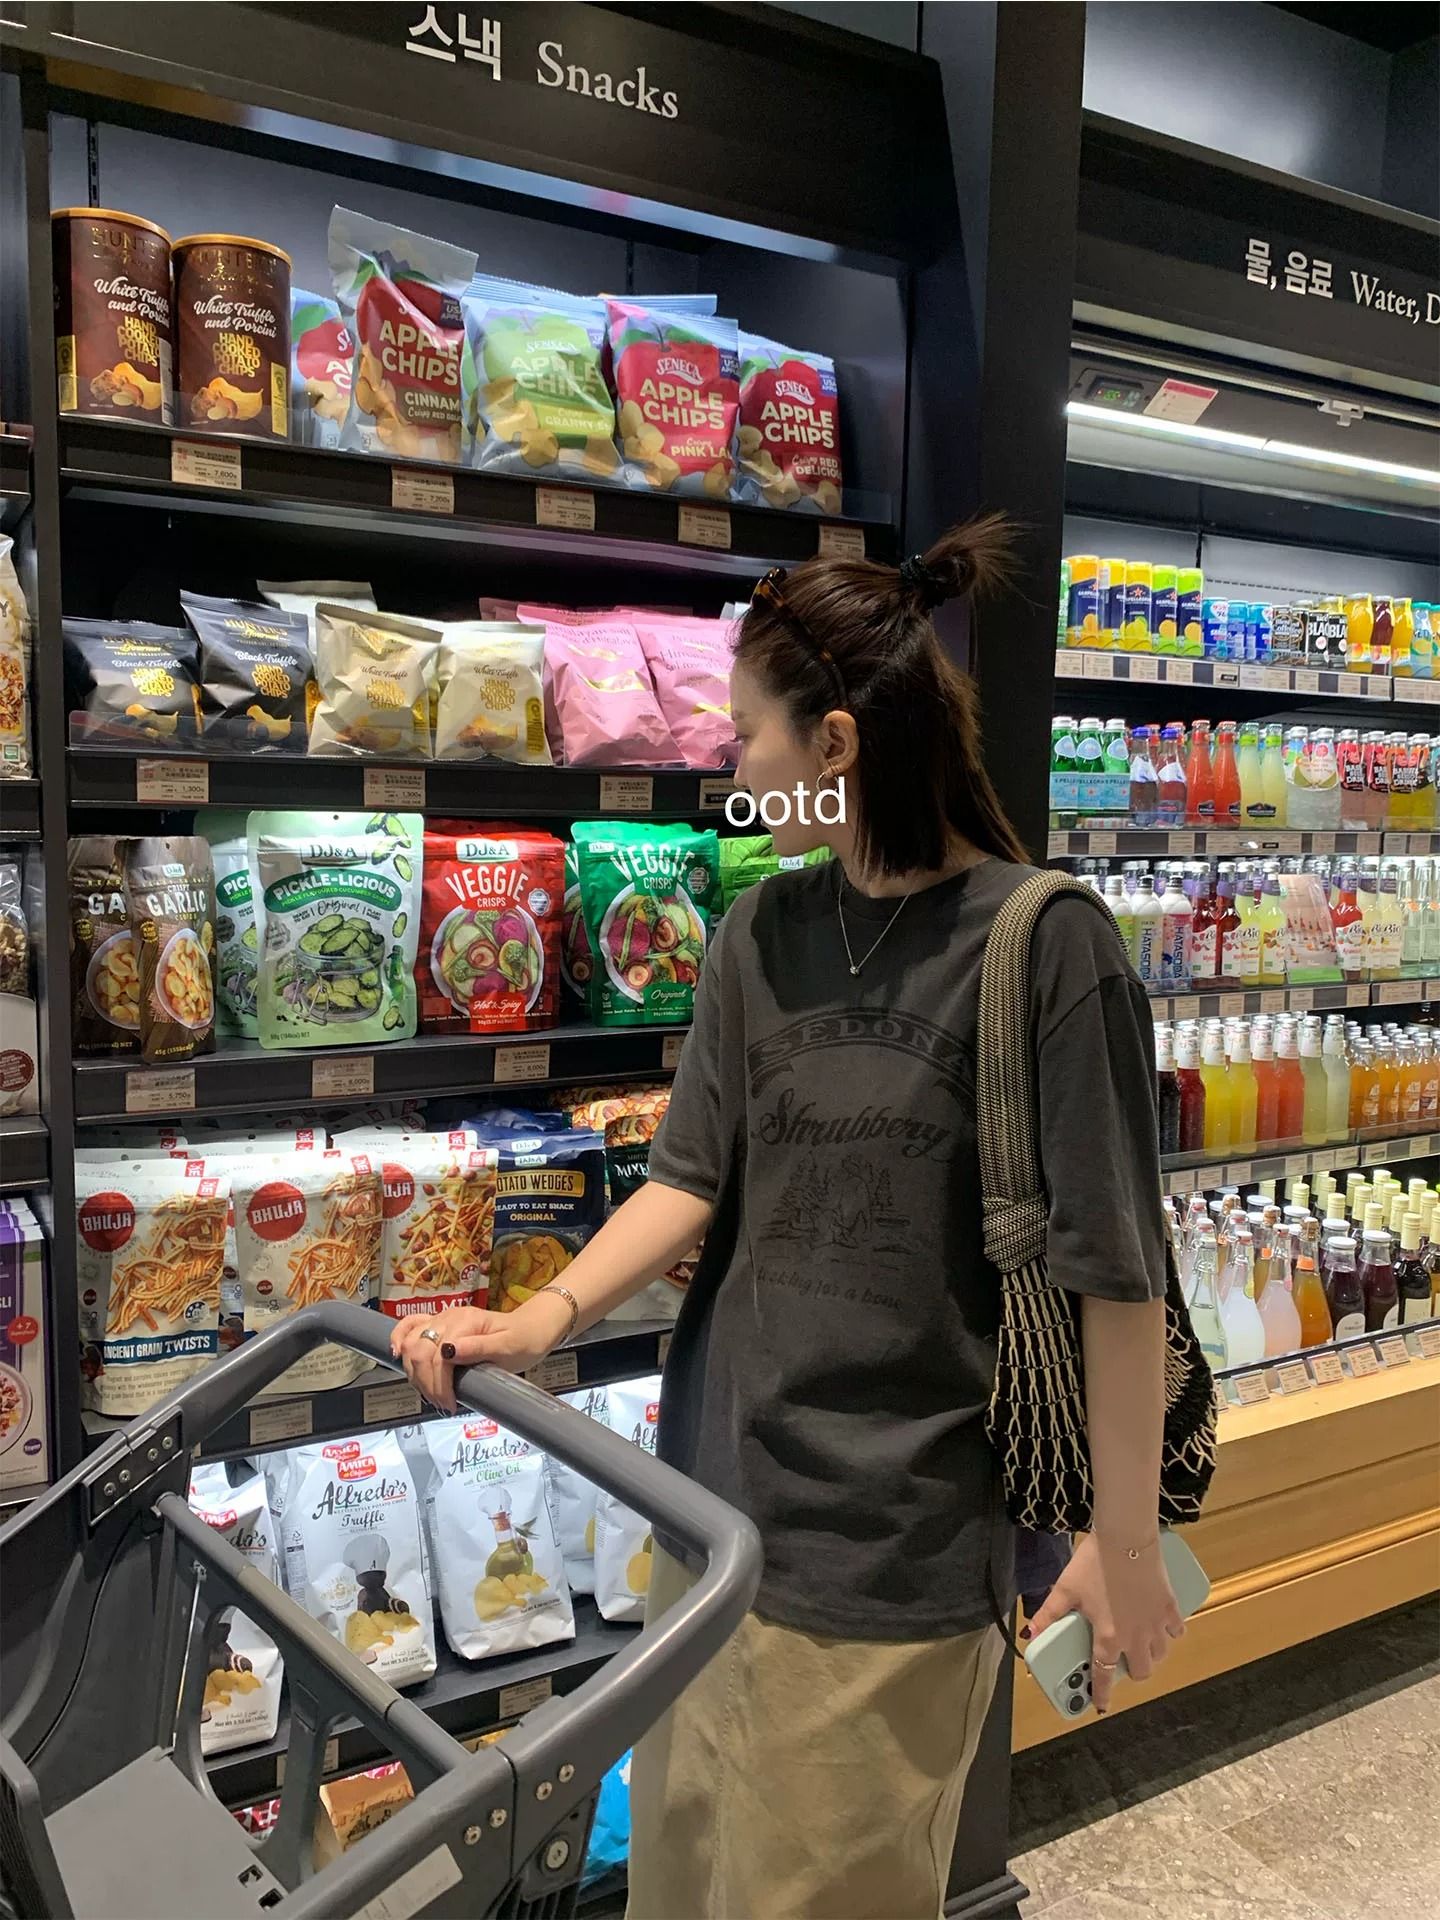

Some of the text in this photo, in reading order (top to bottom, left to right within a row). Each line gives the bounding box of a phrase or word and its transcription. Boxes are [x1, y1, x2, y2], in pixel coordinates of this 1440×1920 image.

[405, 4, 501, 81] 스낵
[536, 41, 679, 118] Snacks
[94, 276, 138, 299] White
[1349, 271, 1421, 324] Water,
[108, 300, 137, 313] and
[193, 294, 276, 323] White Truffle
[124, 315, 157, 333] HAND
[204, 317, 277, 338] and Porcini
[219, 332, 254, 346] HAND
[379, 320, 459, 361] APPLE
[124, 347, 158, 368] CHIPS
[212, 342, 260, 359] COOKED
[213, 352, 260, 369] POTATO
[382, 347, 458, 386] CHIPS
[218, 363, 256, 378] CHIPS
[656, 358, 704, 383] SENECA
[640, 378, 724, 411] APPLE
[775, 381, 815, 404] SENECA
[643, 400, 725, 430] CHIPS
[760, 401, 834, 430] APPLE
[765, 422, 834, 449] CHIPS
[671, 445, 706, 458] PINK
[820, 457, 838, 468] RED
[112, 659, 182, 670] Black Truffle
[235, 650, 298, 667] Black Truffle
[251, 671, 290, 683] COOKED
[255, 663, 283, 675] HAND
[138, 685, 172, 697] CHIPS
[254, 678, 291, 691] POTATO
[261, 686, 289, 699] CHIPS
[480, 686, 516, 697] COOKED
[484, 679, 510, 689] HAND
[481, 692, 515, 704] POTATO
[485, 702, 512, 712] CHIPS
[309, 844, 358, 859] DJ&A
[465, 843, 510, 857] DJ&A
[610, 843, 695, 882] VEGGIE
[272, 873, 397, 900] PICKLE-LICIOUS
[445, 865, 529, 902] VEGGIE
[643, 877, 674, 890] CRISPS
[146, 890, 207, 917] GARLIC
[317, 900, 362, 915] Original
[477, 897, 506, 908] CRISPS
[651, 989, 688, 1004] Original
[473, 999, 492, 1010] Hot
[498, 999, 522, 1013] Spicy
[532, 1174, 574, 1191] WEDGES
[251, 1199, 304, 1226] BHUJA
[532, 1202, 548, 1210] EAT
[549, 1203, 574, 1211] SNACK
[82, 1211, 133, 1233] BHUJA
[510, 1213, 556, 1222] ORIGINAL
[396, 1300, 437, 1317] ORIGINAL
[103, 1335, 210, 1359] ANCIENT GRAIN TWISTS
[338, 1457, 376, 1473] AMICA
[447, 1438, 530, 1477] Alfredo's
[476, 1469, 504, 1483] Olive
[505, 1463, 521, 1476] Oil
[312, 1478, 408, 1520] Alfredo's
[342, 1509, 385, 1527] Truffle
